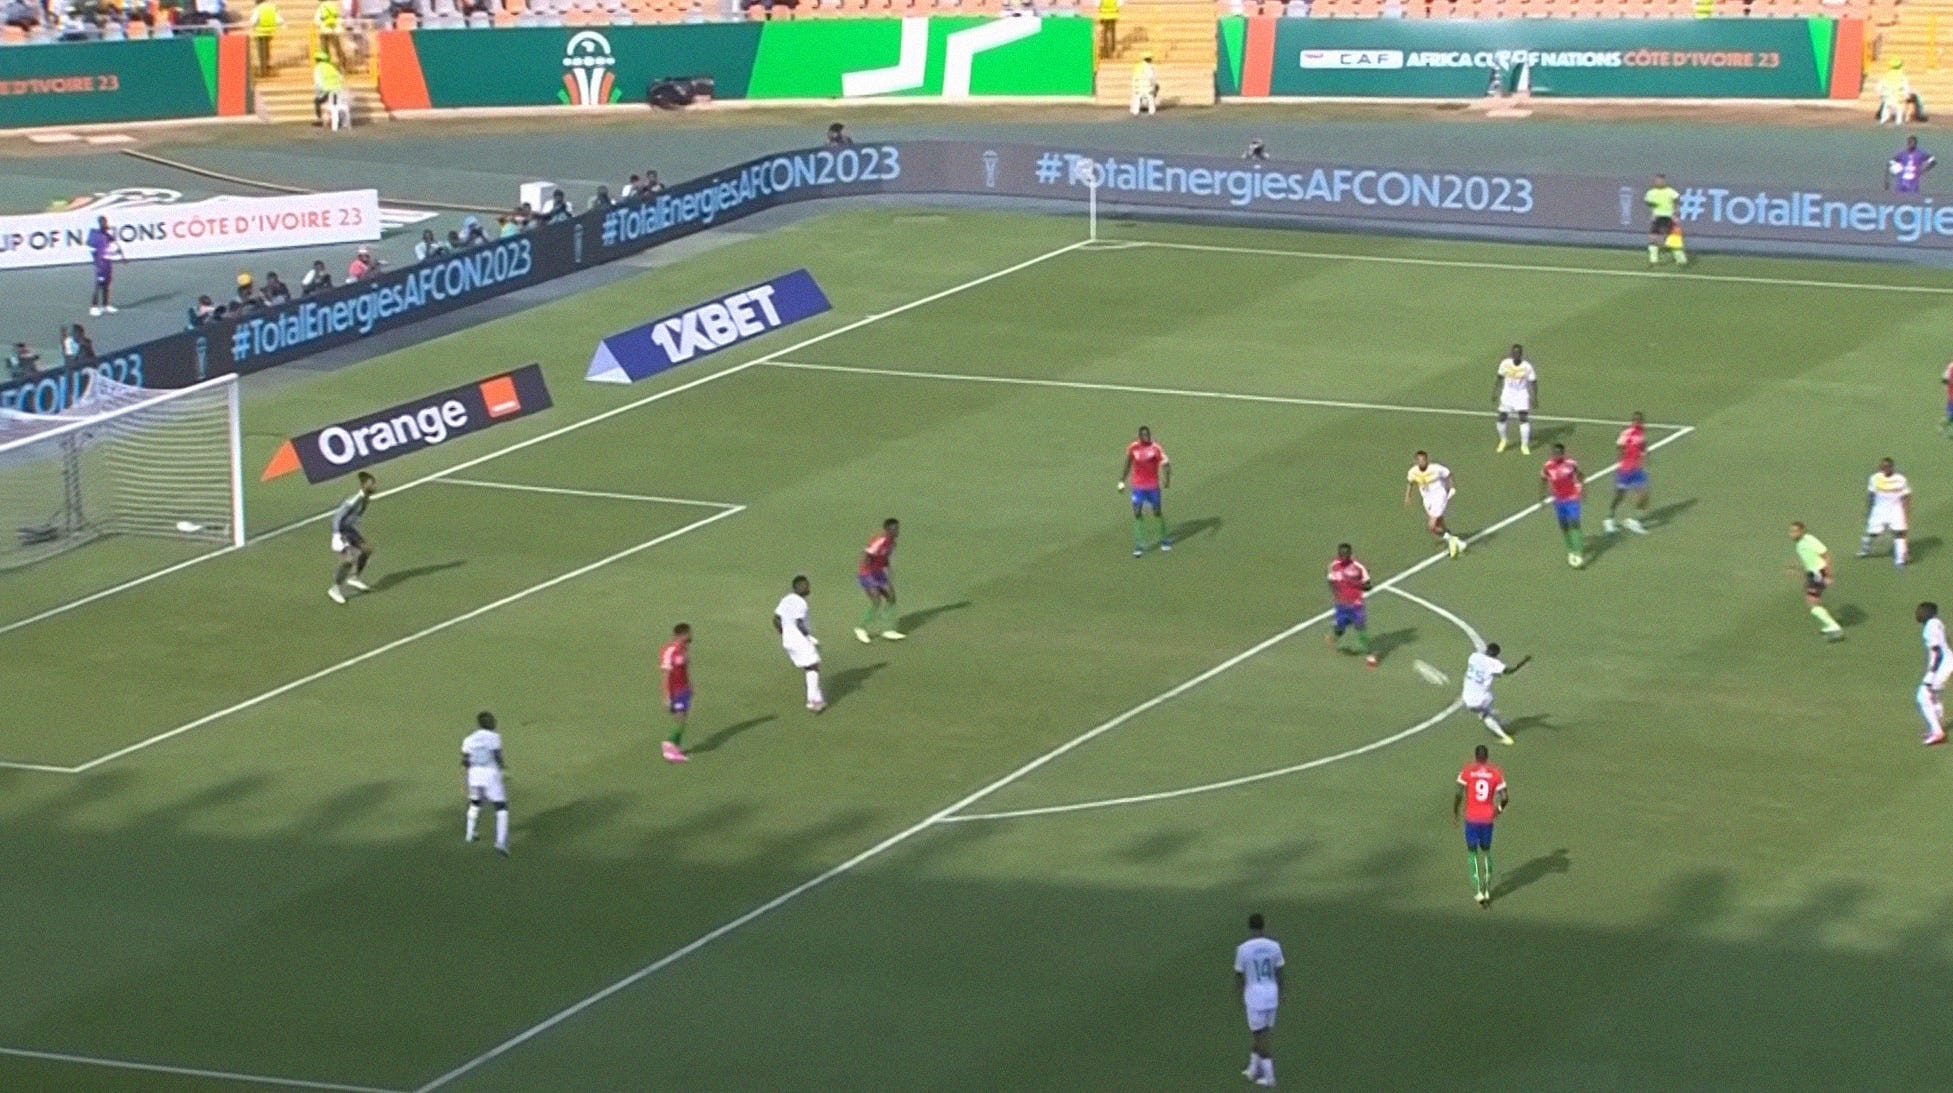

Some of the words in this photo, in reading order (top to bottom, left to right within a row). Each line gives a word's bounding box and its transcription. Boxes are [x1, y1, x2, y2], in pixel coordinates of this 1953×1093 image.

[1340, 53, 1389, 65] CAF
[1406, 52, 1473, 68] AFRICA
[1541, 52, 1622, 68] NATIONS
[1623, 49, 1669, 68] CÔTE
[1757, 52, 1780, 68] 23
[97, 75, 119, 91] 23
[603, 146, 900, 245] #TotalEnergiesAFCON2023
[29, 230, 61, 250] OF
[66, 221, 167, 247] NIONS
[172, 215, 229, 239] CÔTE
[235, 209, 332, 234] D'IVOIRE
[338, 207, 362, 227] 23
[232, 238, 532, 362] #TotalEnergiesAFCON2023
[651, 284, 782, 363] 1XBET
[318, 399, 468, 465] Orange
[1475, 779, 1489, 801] 9
[1252, 957, 1272, 983] 14
